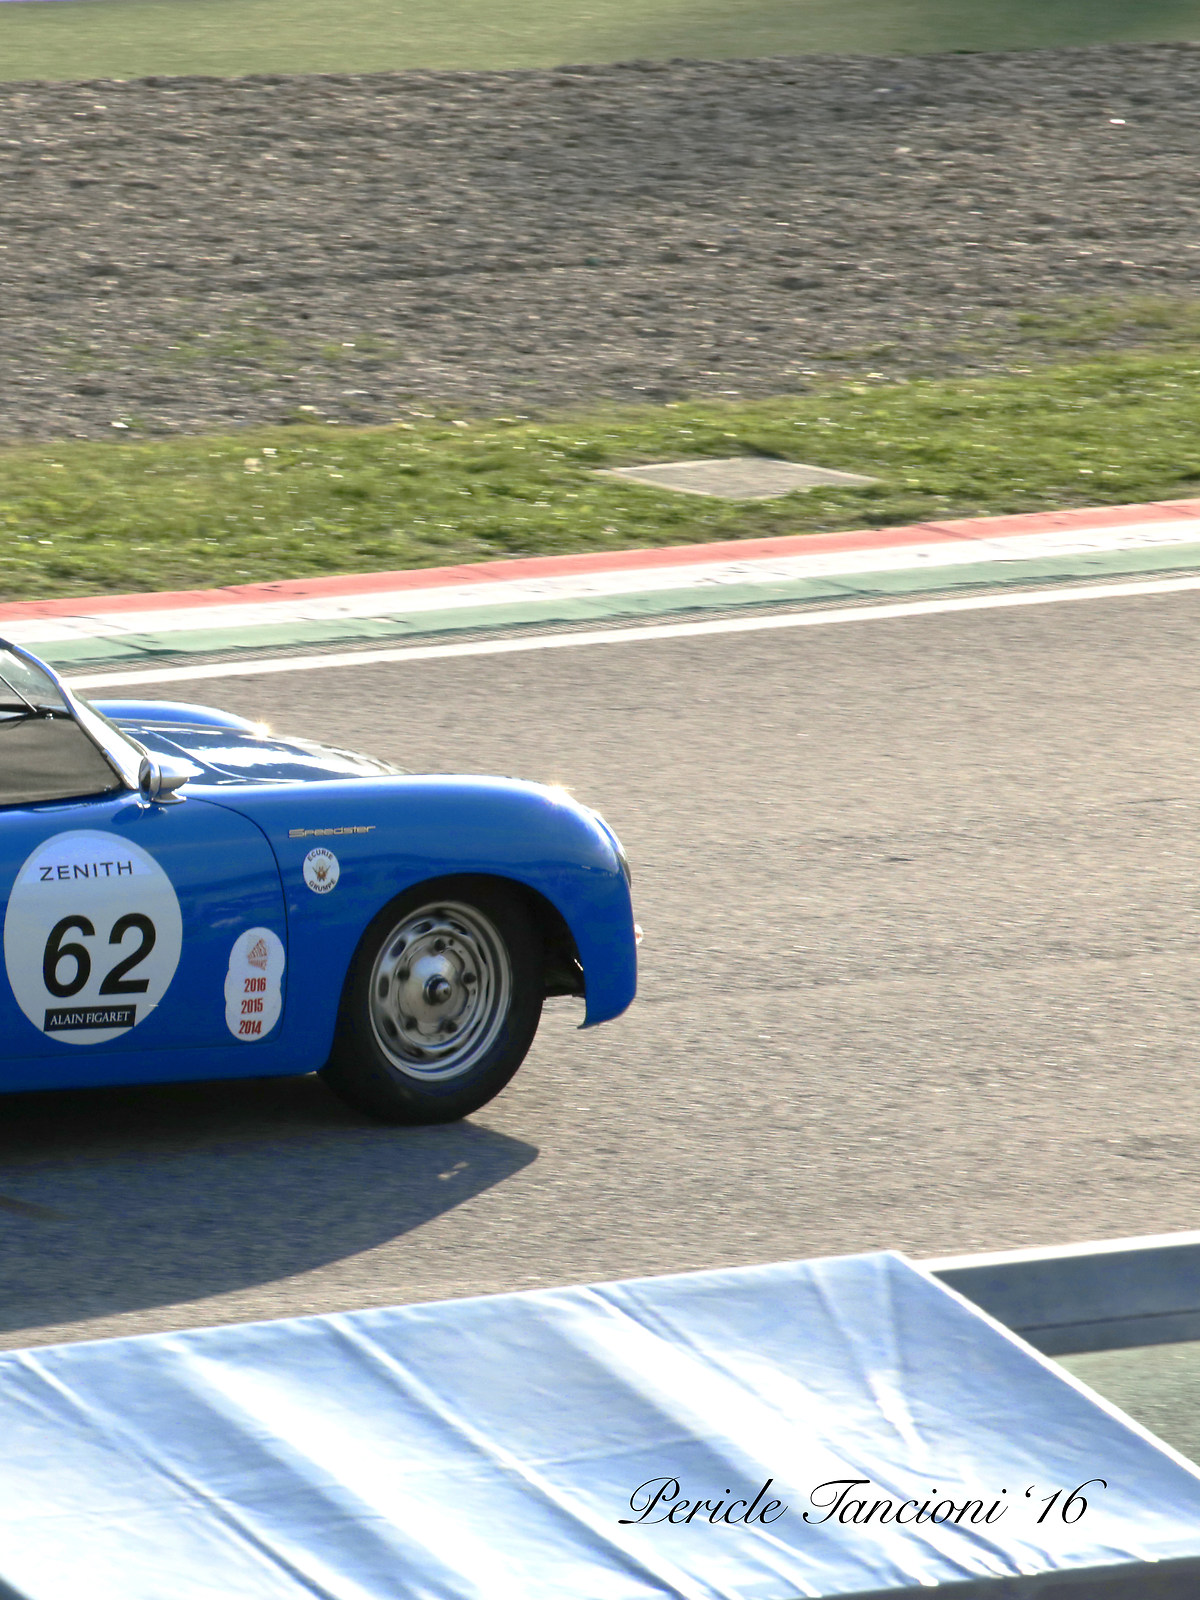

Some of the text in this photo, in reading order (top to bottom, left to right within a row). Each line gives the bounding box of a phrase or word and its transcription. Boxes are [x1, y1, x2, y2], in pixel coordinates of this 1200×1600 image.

[288, 825, 376, 838] Speedster
[307, 849, 334, 862] ECURIE
[39, 861, 133, 881] ZENITH
[42, 912, 156, 998] 62
[244, 977, 266, 993] 2016
[241, 998, 263, 1014] 2015
[50, 1011, 130, 1026] ALAIN FIGARET
[238, 1020, 261, 1034] 2014
